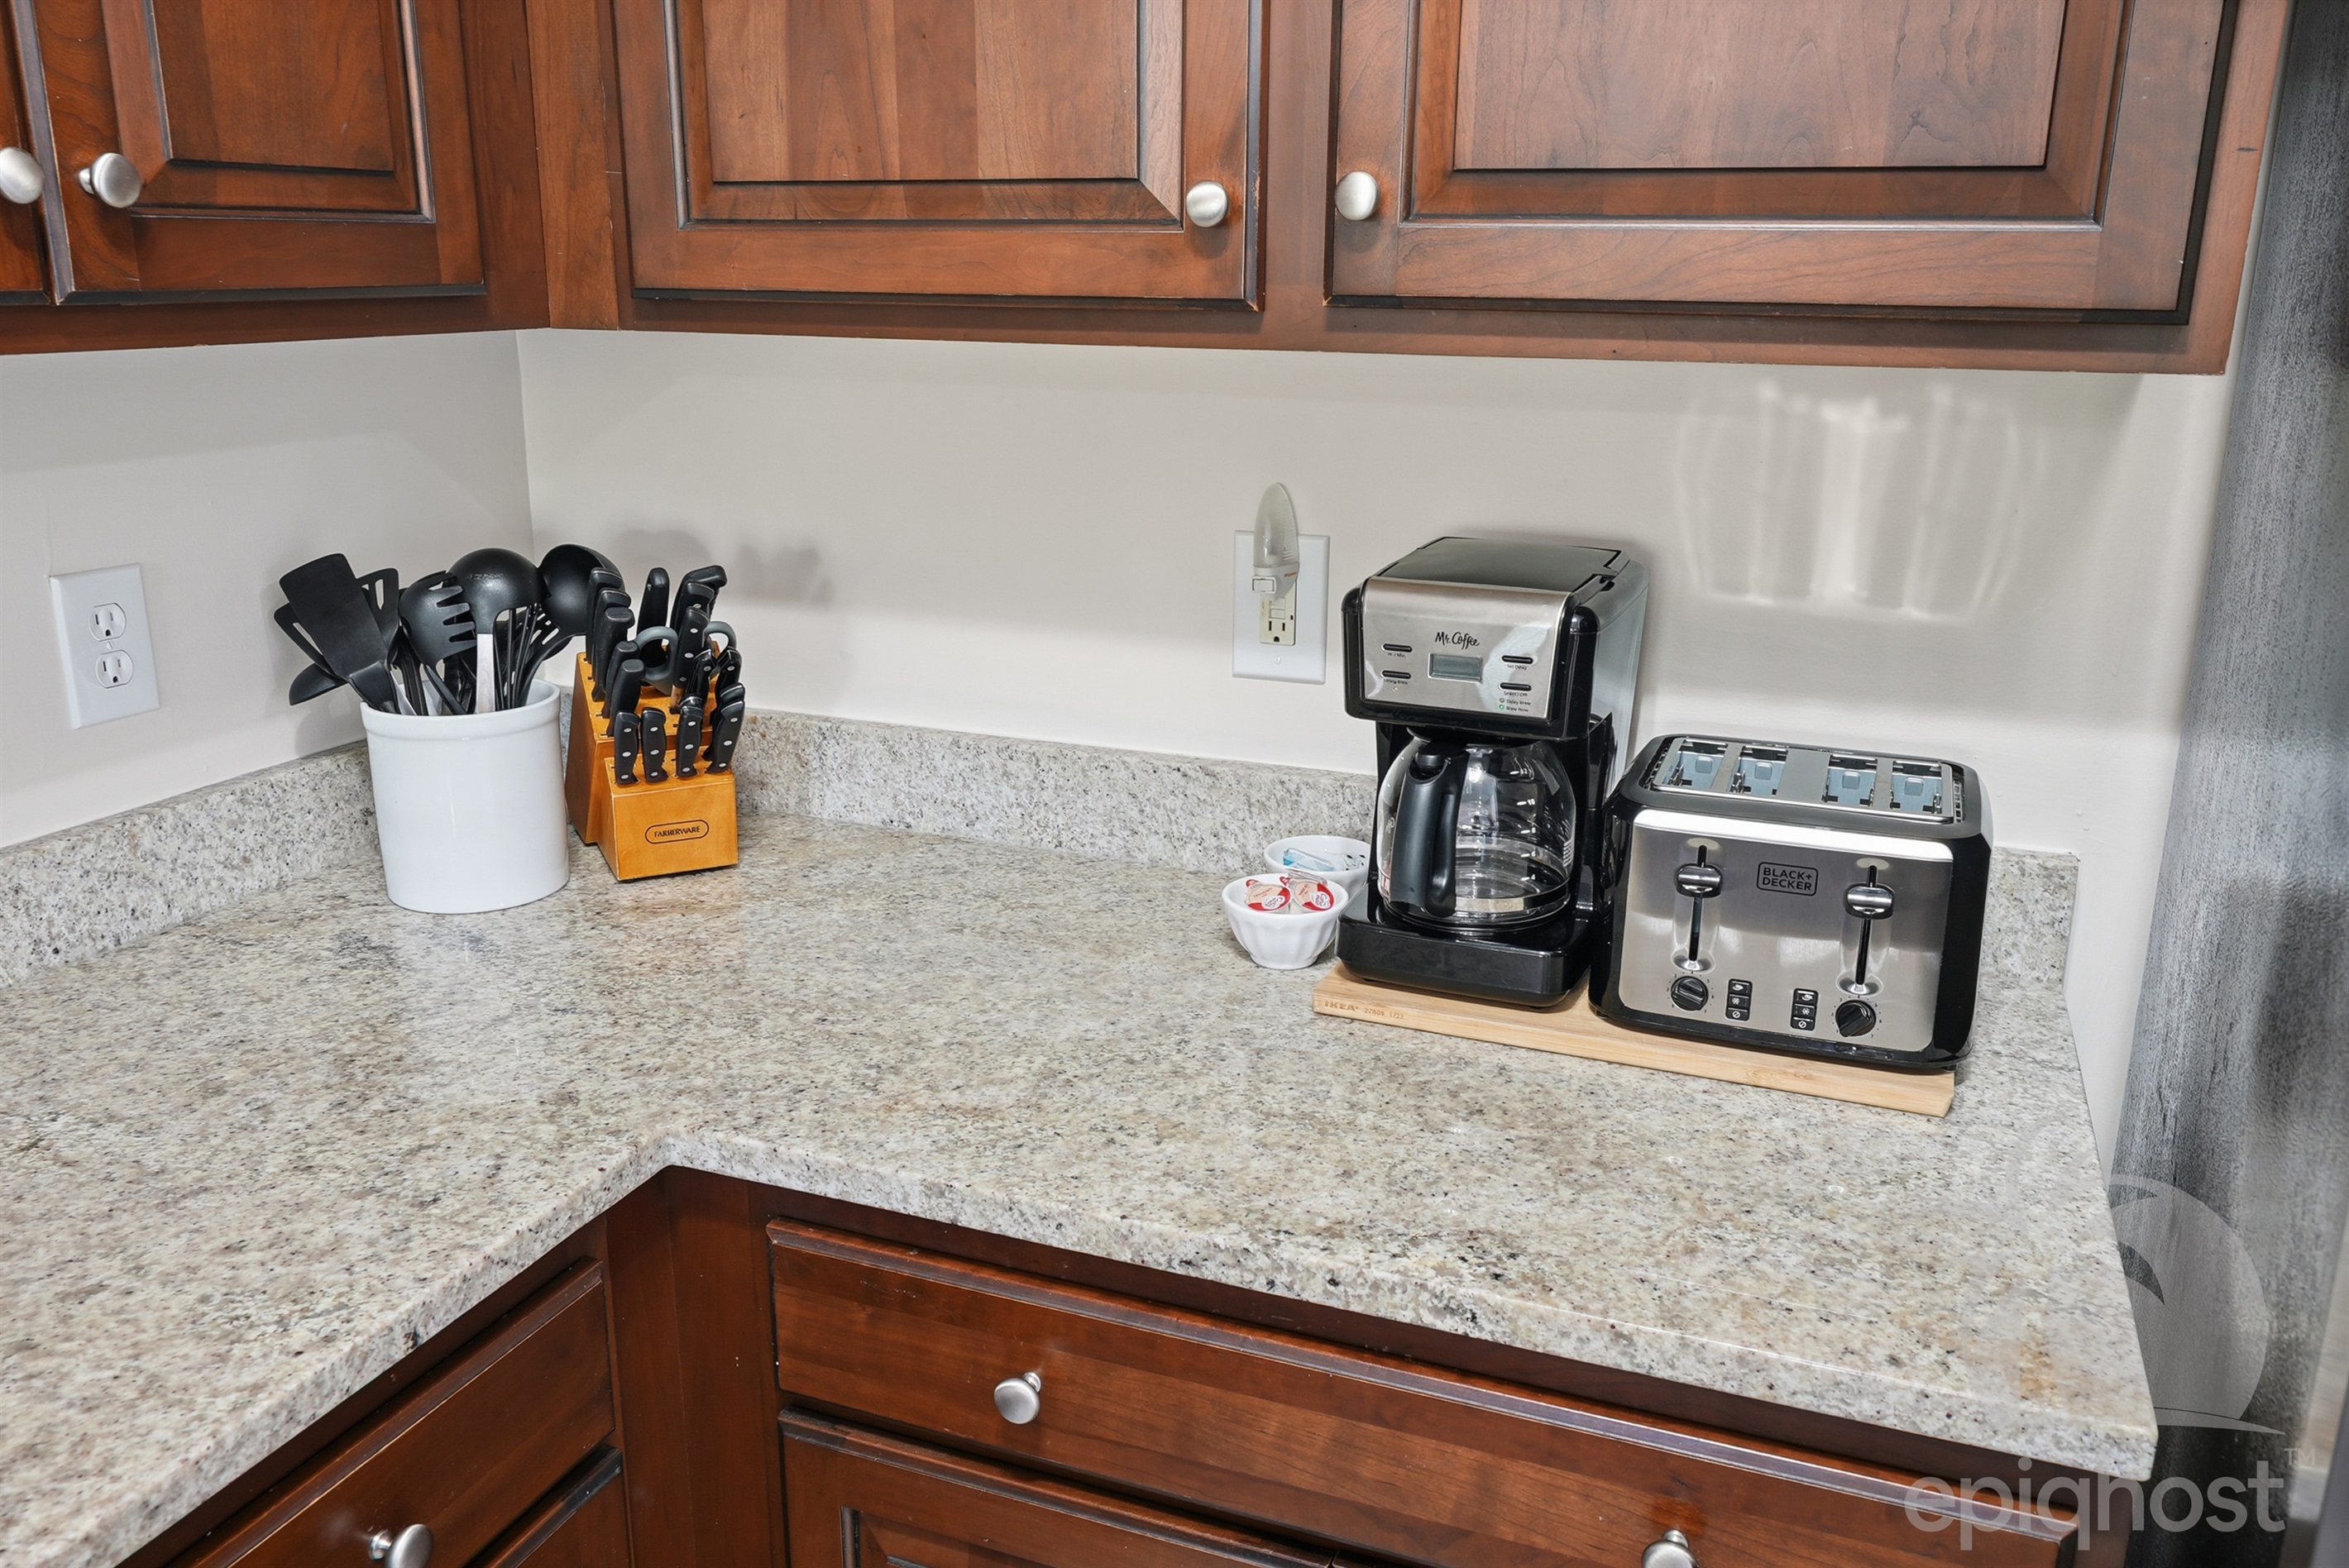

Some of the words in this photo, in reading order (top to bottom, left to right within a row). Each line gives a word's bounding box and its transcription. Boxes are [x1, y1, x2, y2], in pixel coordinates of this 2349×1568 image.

[1435, 631, 1452, 645] Mr.
[1452, 631, 1481, 650] Coffee
[653, 825, 701, 838] FARBERWARE
[1763, 867, 1812, 882] BLACK+
[1762, 877, 1812, 892] DECKER
